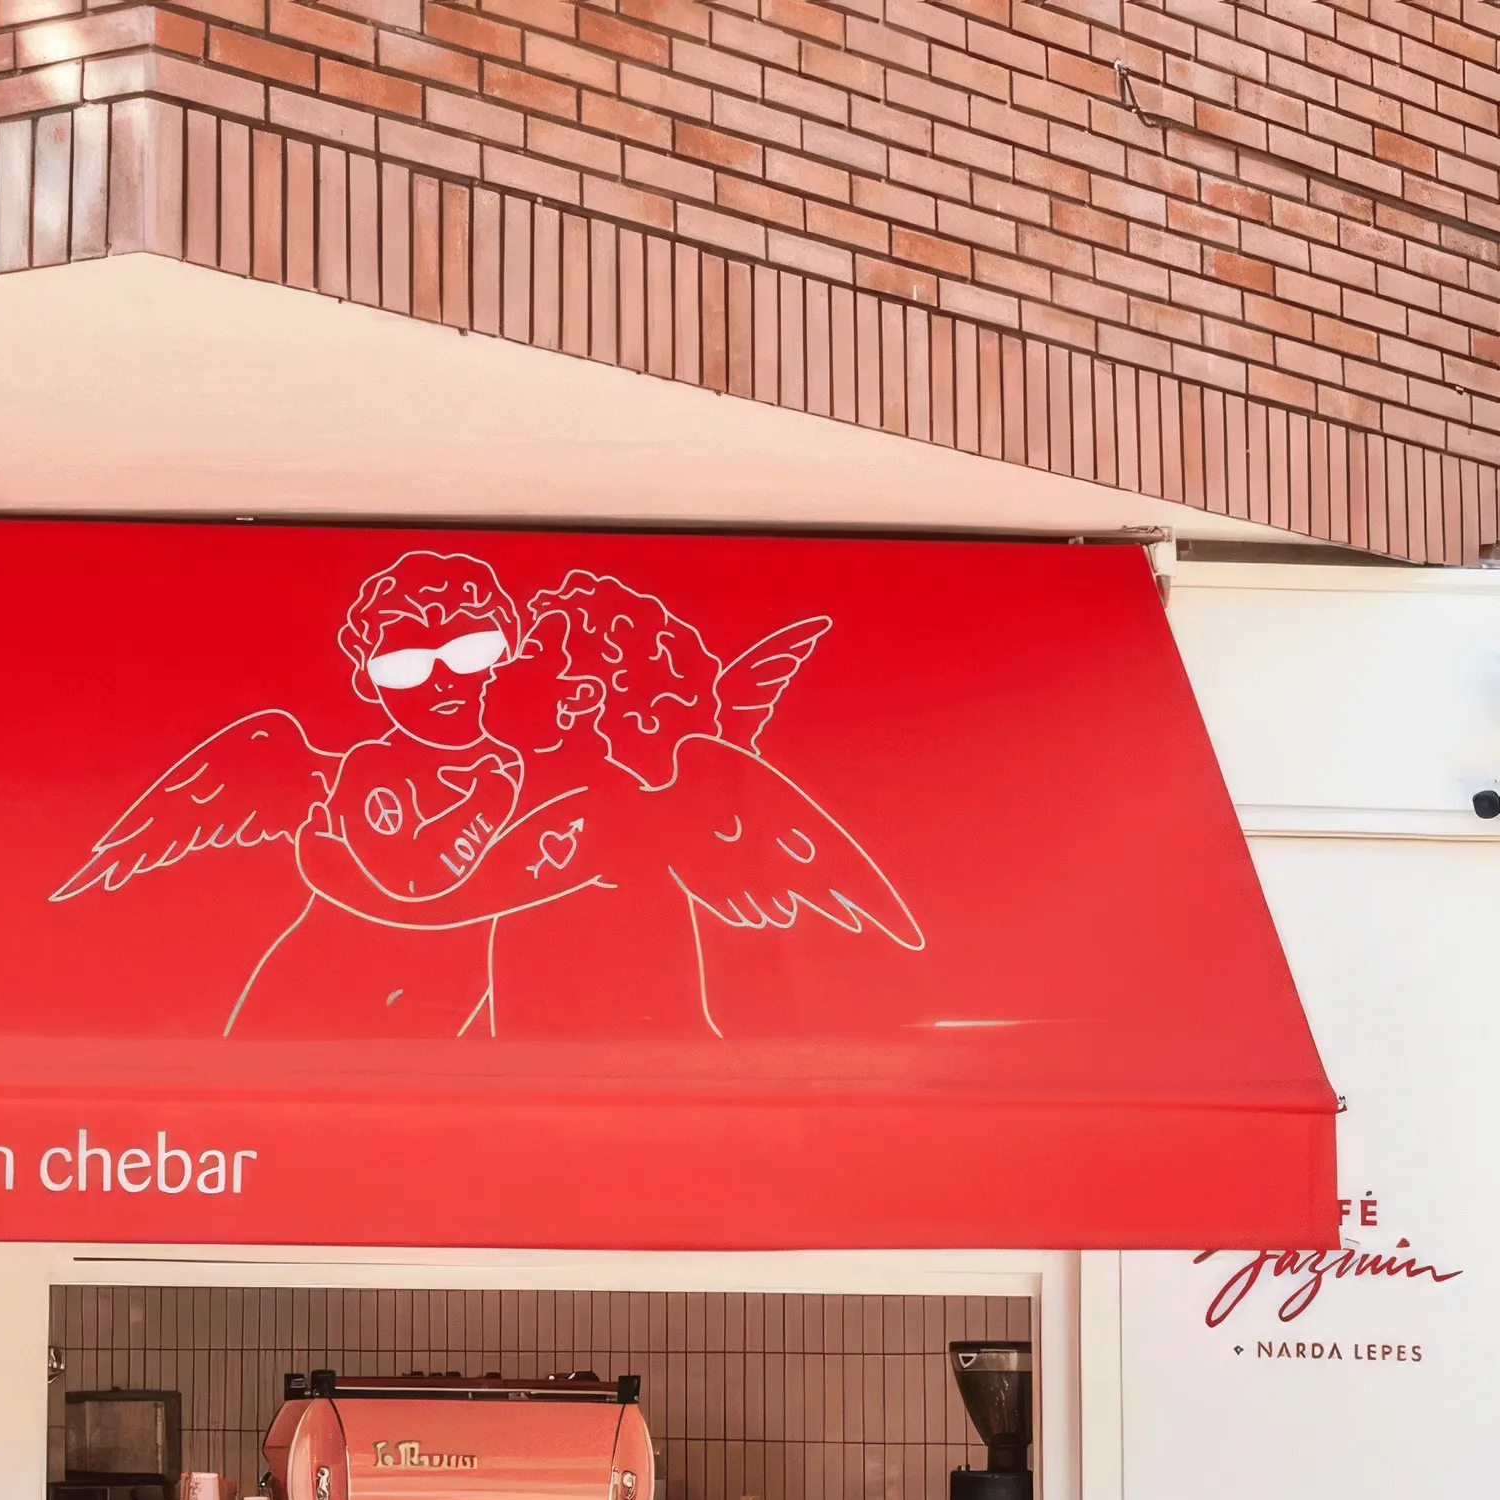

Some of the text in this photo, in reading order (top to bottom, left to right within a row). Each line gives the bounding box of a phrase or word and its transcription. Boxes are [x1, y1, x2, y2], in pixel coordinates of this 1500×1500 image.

[439, 812, 495, 877] LOVE
[39, 1128, 258, 1195] chebar
[1338, 1190, 1378, 1227] FÉ
[1257, 1341, 1423, 1362] NARDA LEPES
